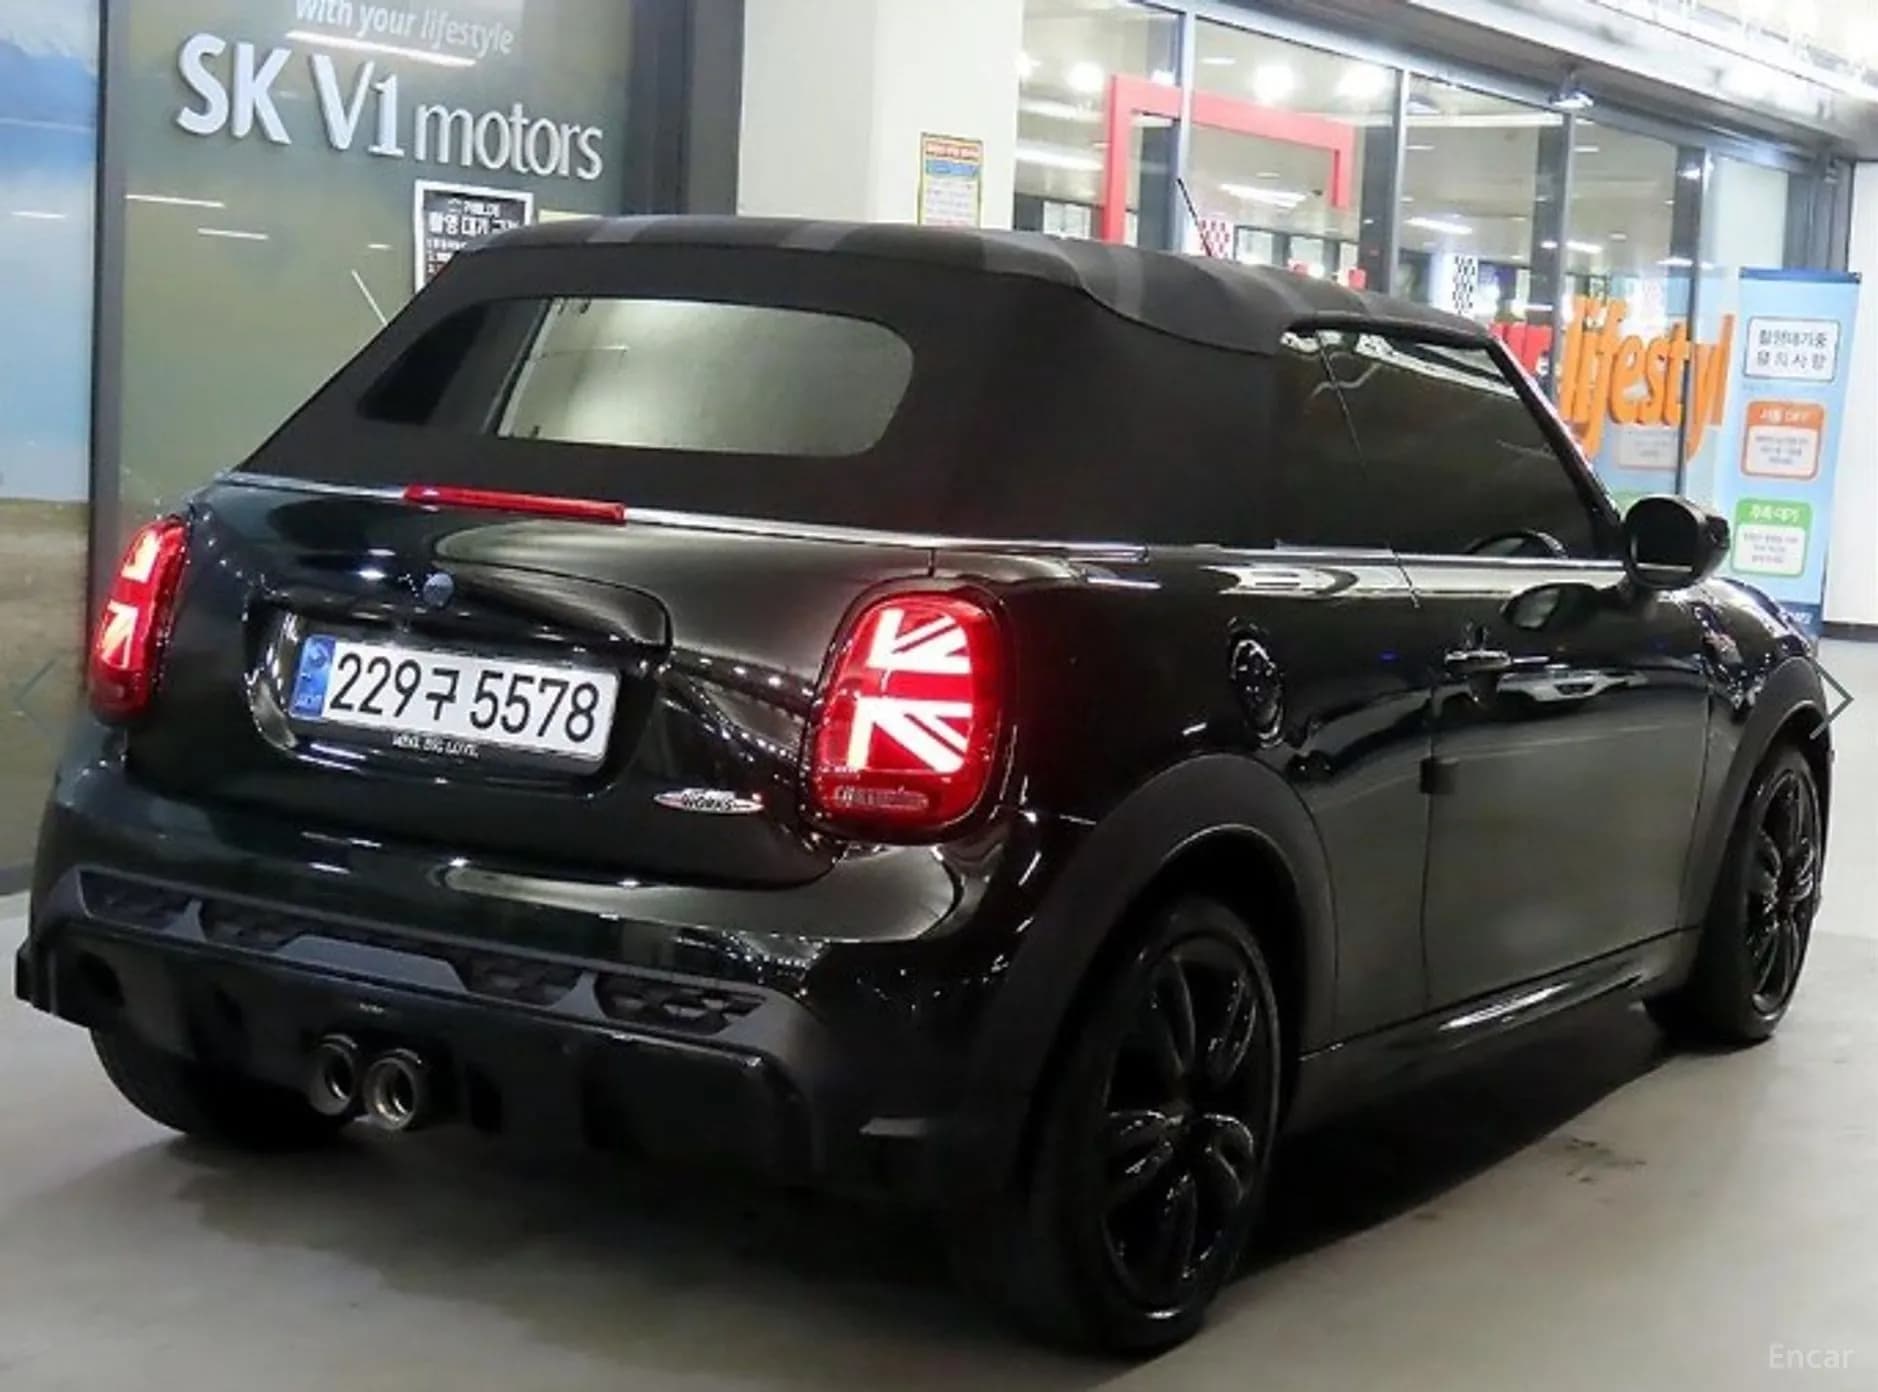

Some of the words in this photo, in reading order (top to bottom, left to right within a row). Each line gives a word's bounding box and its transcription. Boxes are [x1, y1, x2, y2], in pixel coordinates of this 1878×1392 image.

[293, 0, 352, 27] with
[353, 4, 417, 39] your
[420, 9, 514, 58] lifestyle
[176, 32, 293, 146] SK
[308, 52, 405, 157] V1
[414, 101, 603, 181] motors
[329, 652, 461, 721] 229구
[469, 669, 600, 743] 5578
